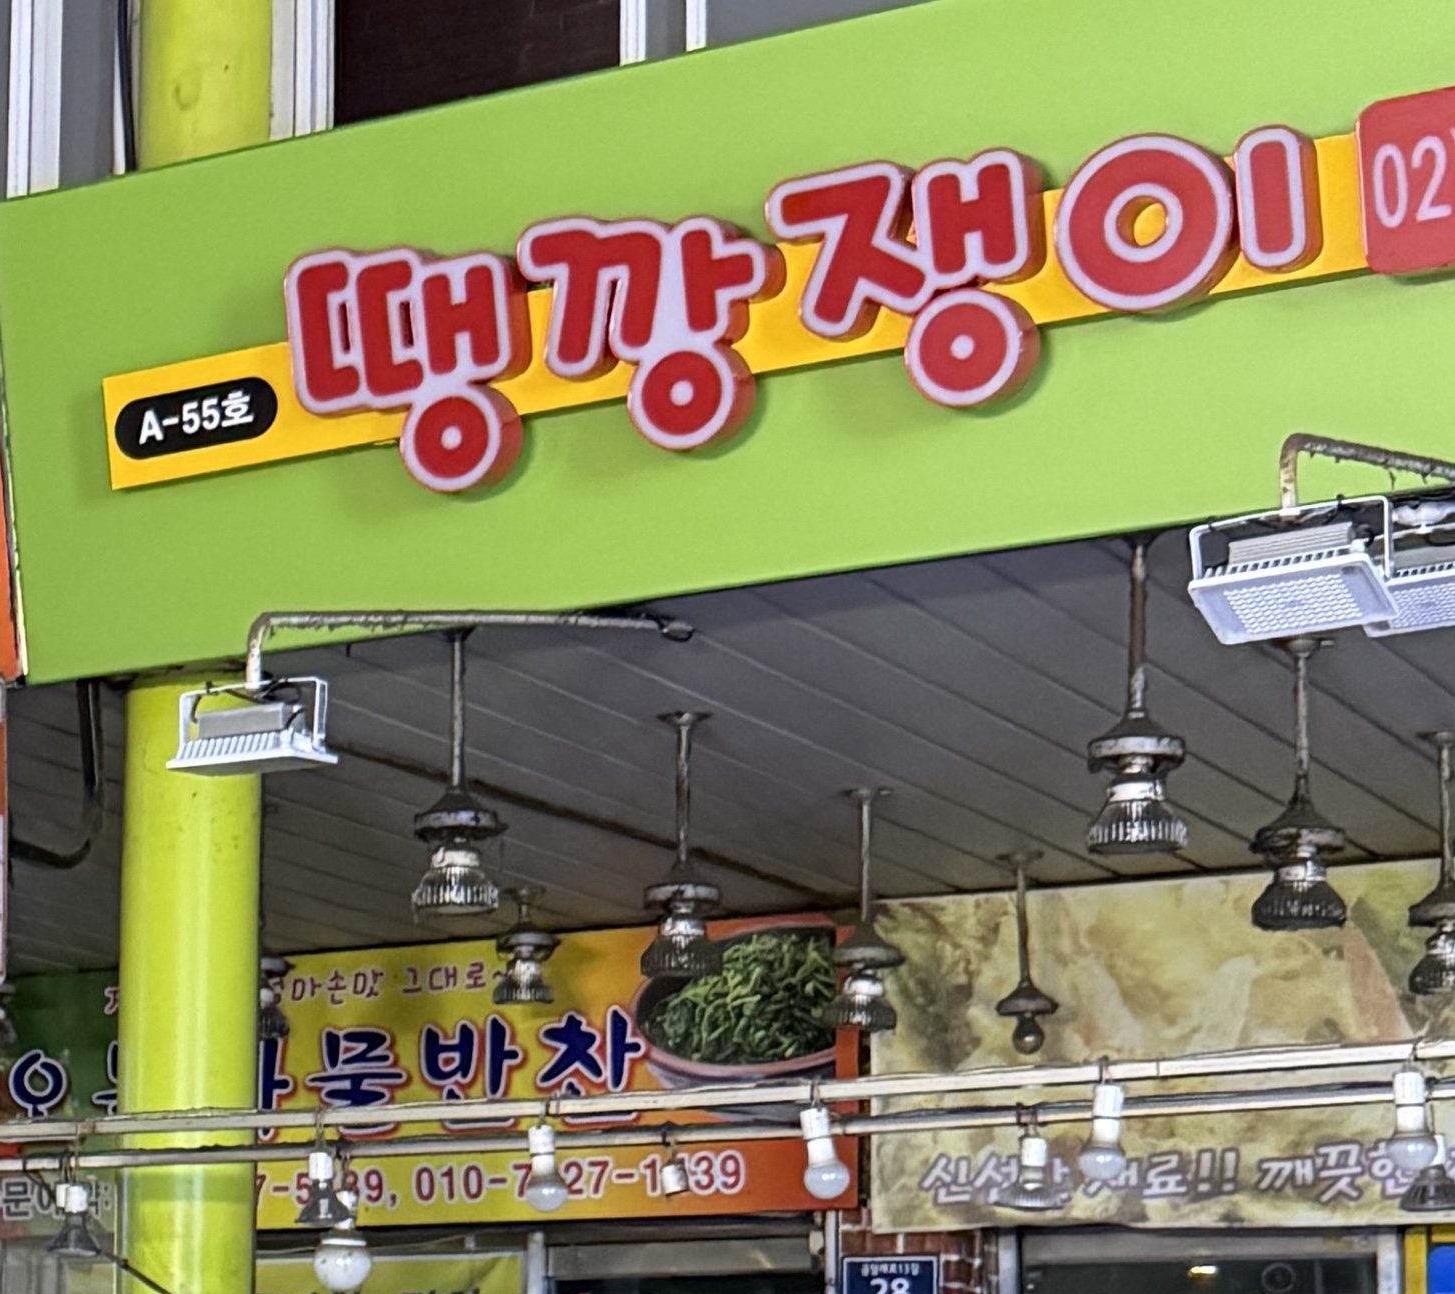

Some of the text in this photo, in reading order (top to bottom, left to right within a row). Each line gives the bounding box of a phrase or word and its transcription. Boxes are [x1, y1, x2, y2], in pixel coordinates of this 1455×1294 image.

[1372, 127, 1455, 229] 02
[284, 125, 1319, 492] 땡깡쟁이
[138, 391, 254, 446] A-55호
[414, 1150, 745, 1203] 010-727-139
